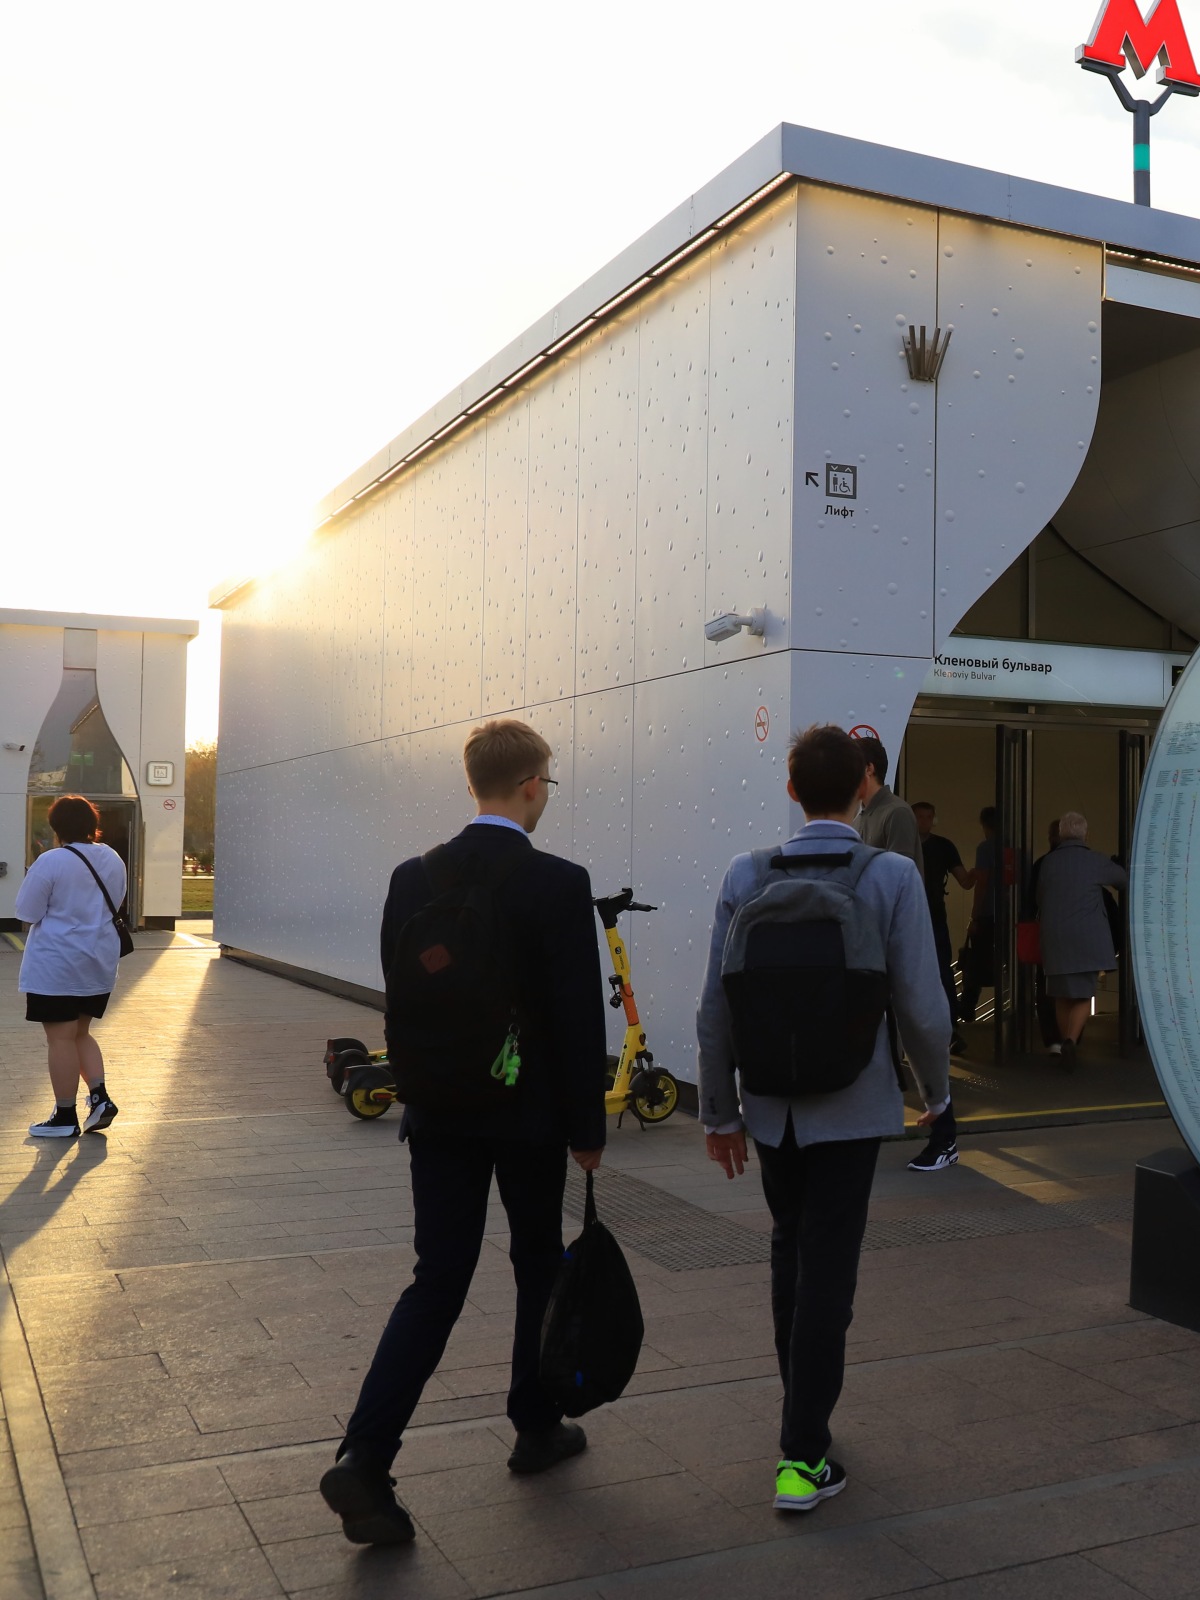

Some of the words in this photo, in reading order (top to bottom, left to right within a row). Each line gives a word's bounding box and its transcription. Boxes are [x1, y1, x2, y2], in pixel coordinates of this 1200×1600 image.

[824, 504, 855, 519] Лифт
[934, 654, 999, 669] Кленовый
[1002, 658, 1052, 675] бульвар
[933, 669, 969, 680] Klenoviy
[971, 671, 997, 681] Bulvar
